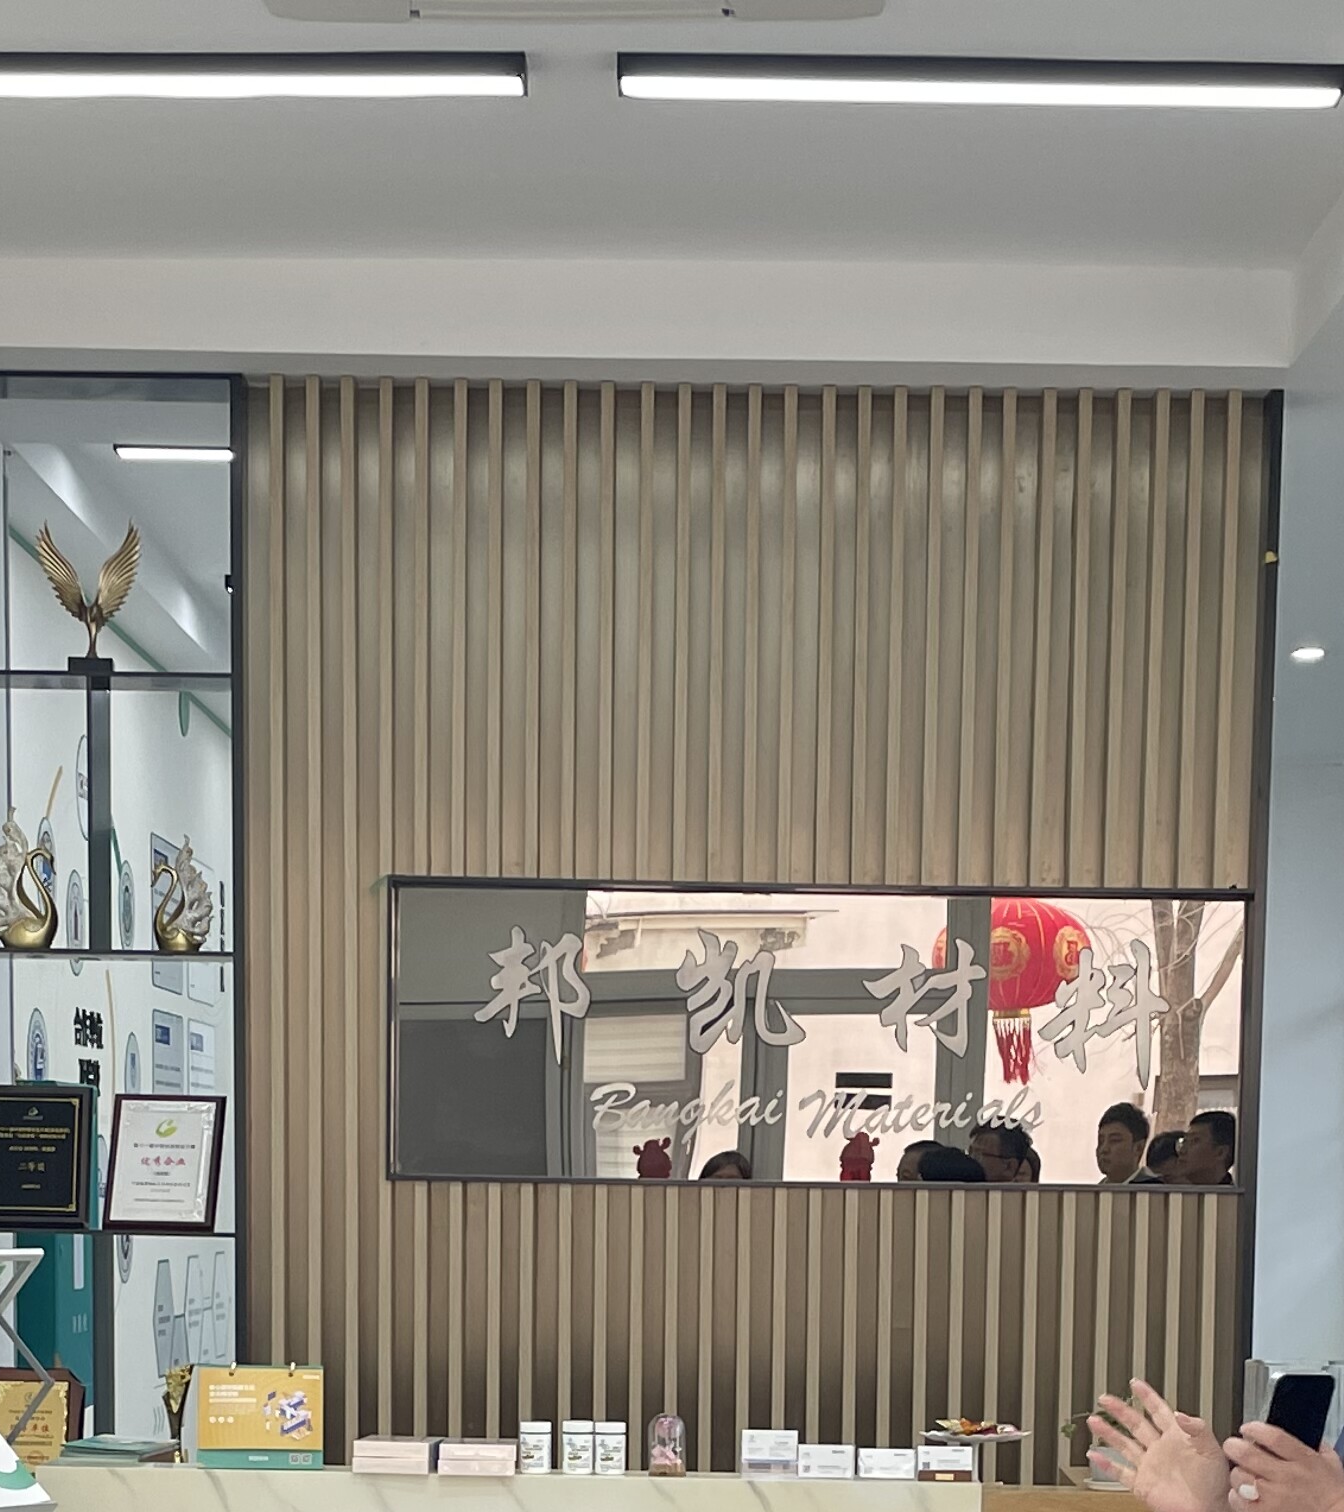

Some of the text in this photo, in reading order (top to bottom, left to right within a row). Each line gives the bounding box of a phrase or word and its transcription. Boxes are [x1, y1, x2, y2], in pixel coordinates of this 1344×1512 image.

[474, 926, 1169, 1090] 邦凯材料
[588, 1081, 1046, 1156] Bangkai Materials
